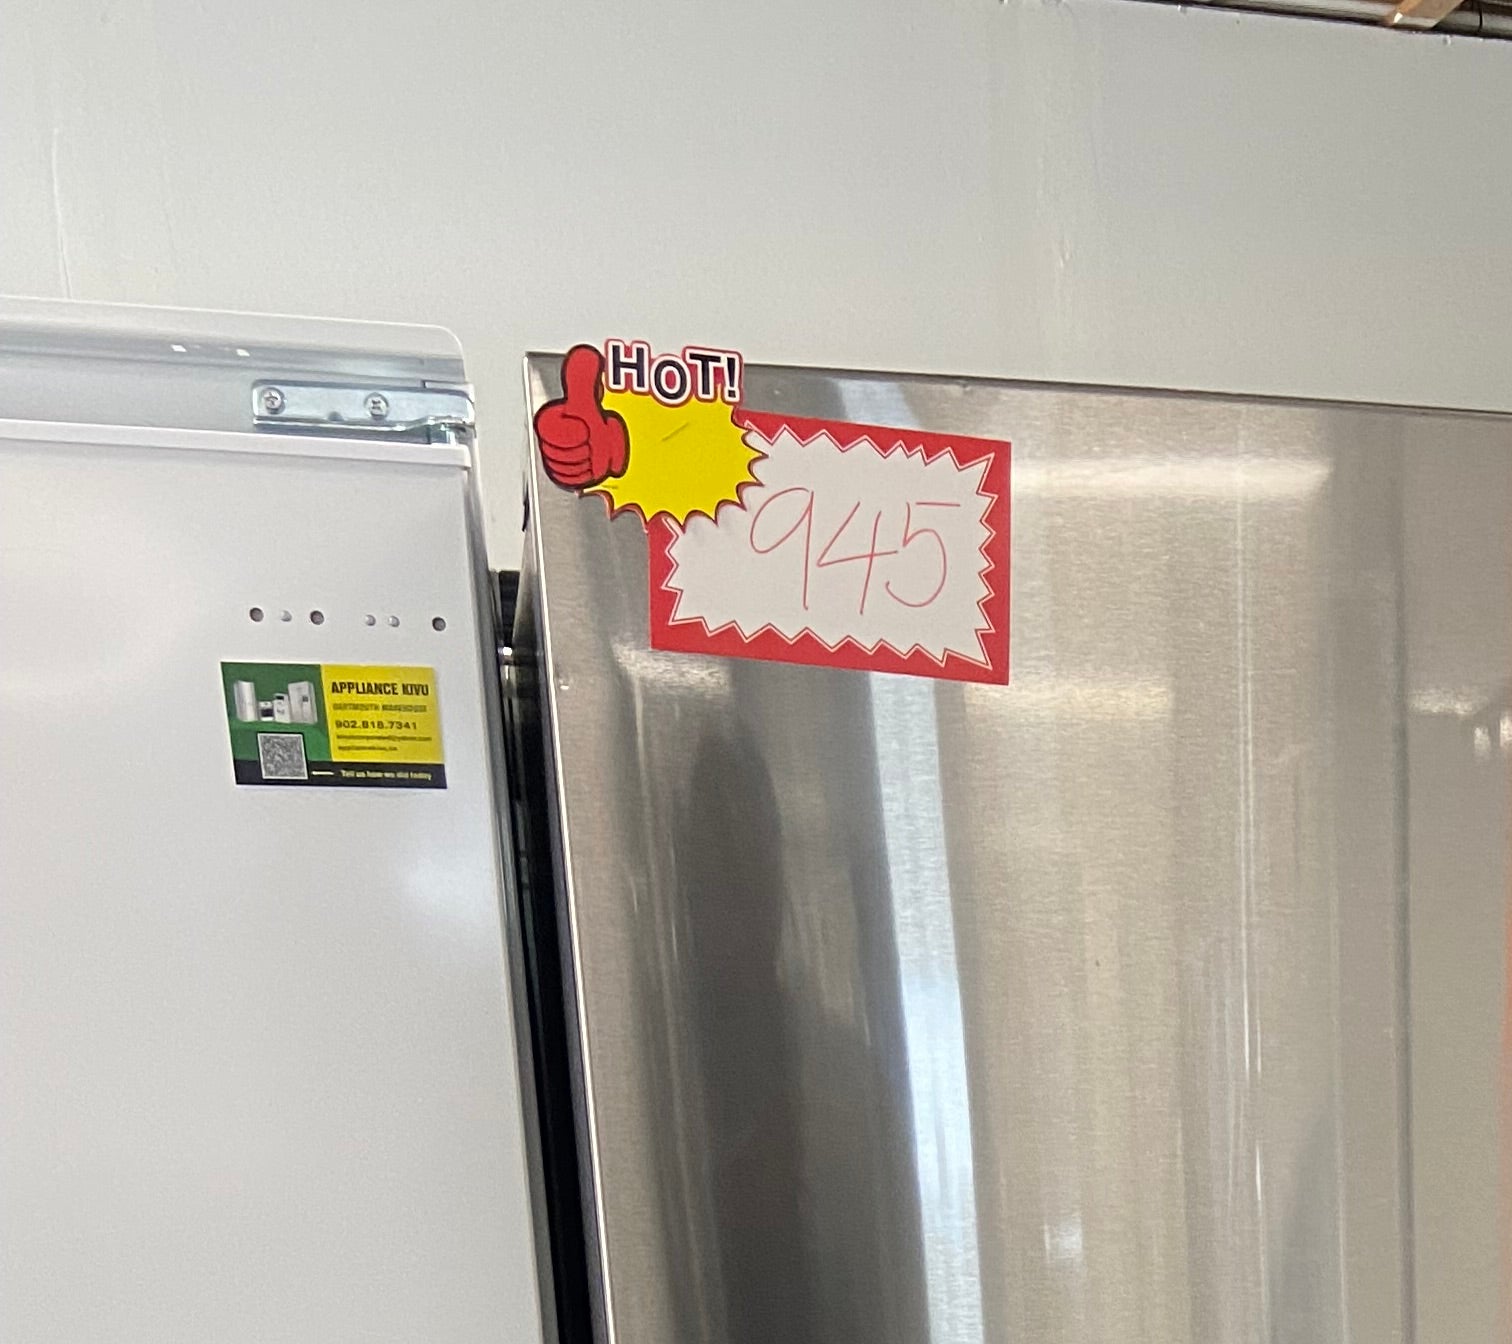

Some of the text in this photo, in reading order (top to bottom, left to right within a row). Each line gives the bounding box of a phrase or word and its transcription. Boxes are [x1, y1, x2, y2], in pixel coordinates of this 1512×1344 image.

[609, 341, 740, 402] HOT!
[750, 487, 960, 616] 945
[331, 681, 429, 696] APPLIANCE KIVU
